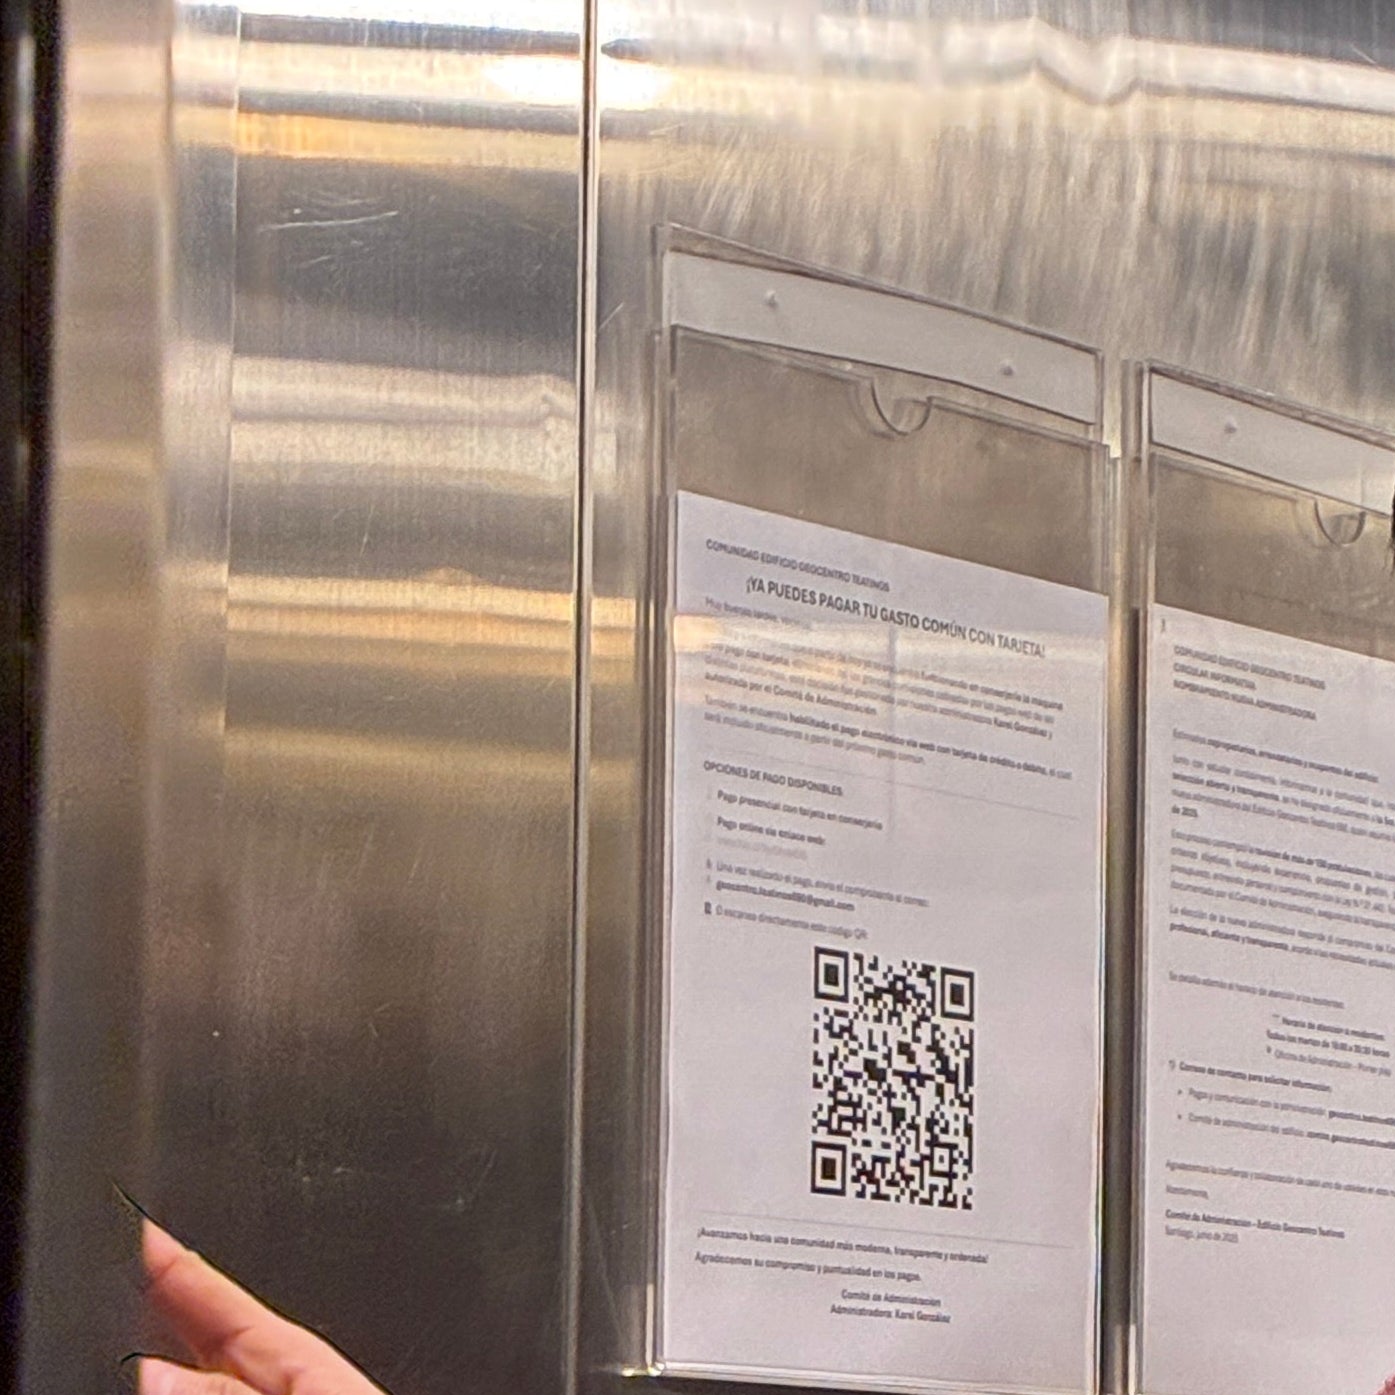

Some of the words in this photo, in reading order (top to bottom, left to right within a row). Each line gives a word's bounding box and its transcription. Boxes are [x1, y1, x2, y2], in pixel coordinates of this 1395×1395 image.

[706, 538, 758, 560] COMUNIDAD
[761, 552, 796, 569] EDIFICIO
[746, 575, 765, 596] ¡YA
[768, 580, 816, 604] PUEDES
[819, 592, 859, 614] PAGAR
[863, 603, 877, 619] TU
[880, 607, 919, 628] GASTO
[922, 613, 966, 639] COMÚN
[969, 628, 995, 646] CON
[997, 634, 1045, 658] TARJETA!
